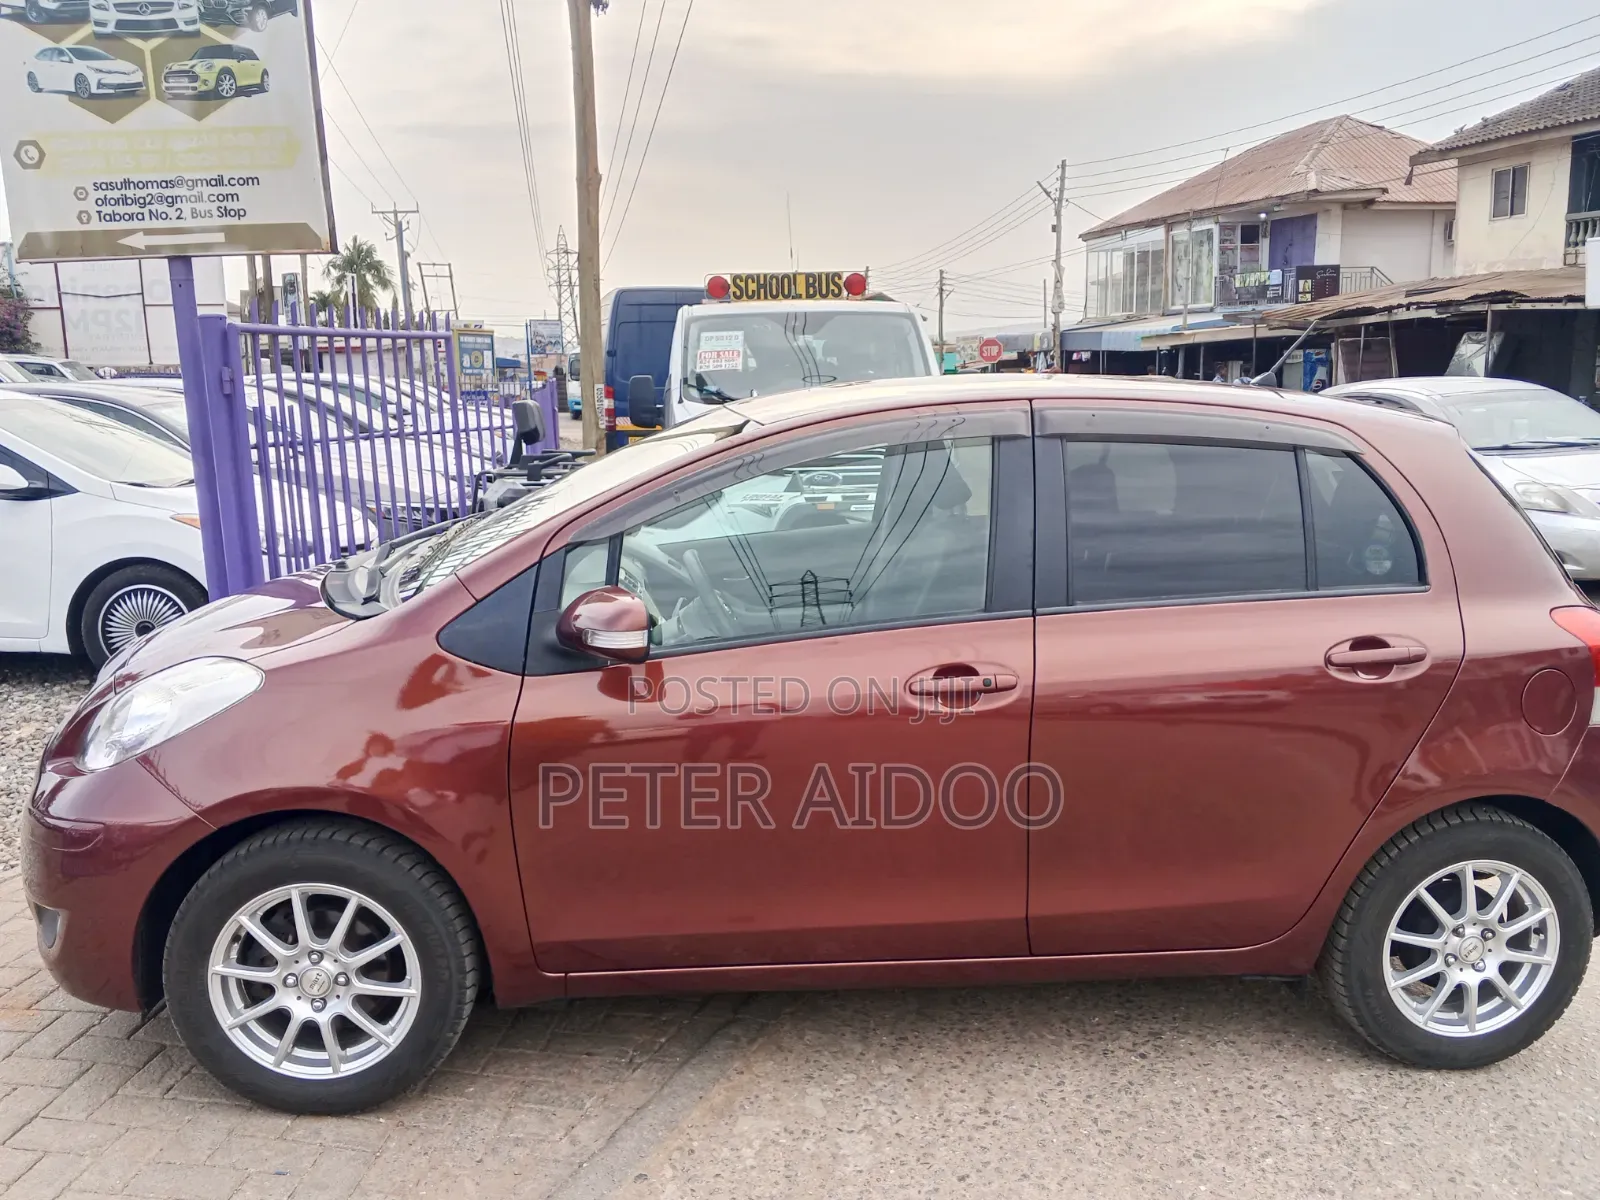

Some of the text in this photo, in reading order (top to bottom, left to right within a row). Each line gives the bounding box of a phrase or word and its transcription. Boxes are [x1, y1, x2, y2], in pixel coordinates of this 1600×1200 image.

[92, 174, 260, 192] sasuthomas@gmail.com
[95, 191, 240, 209] oforibig2@gmail.com
[96, 205, 246, 223] Tabora No. 2, Bus Stop
[732, 272, 842, 300] SCHOOL BUS
[701, 350, 739, 359] FOR SALE
[982, 345, 999, 357] STOP
